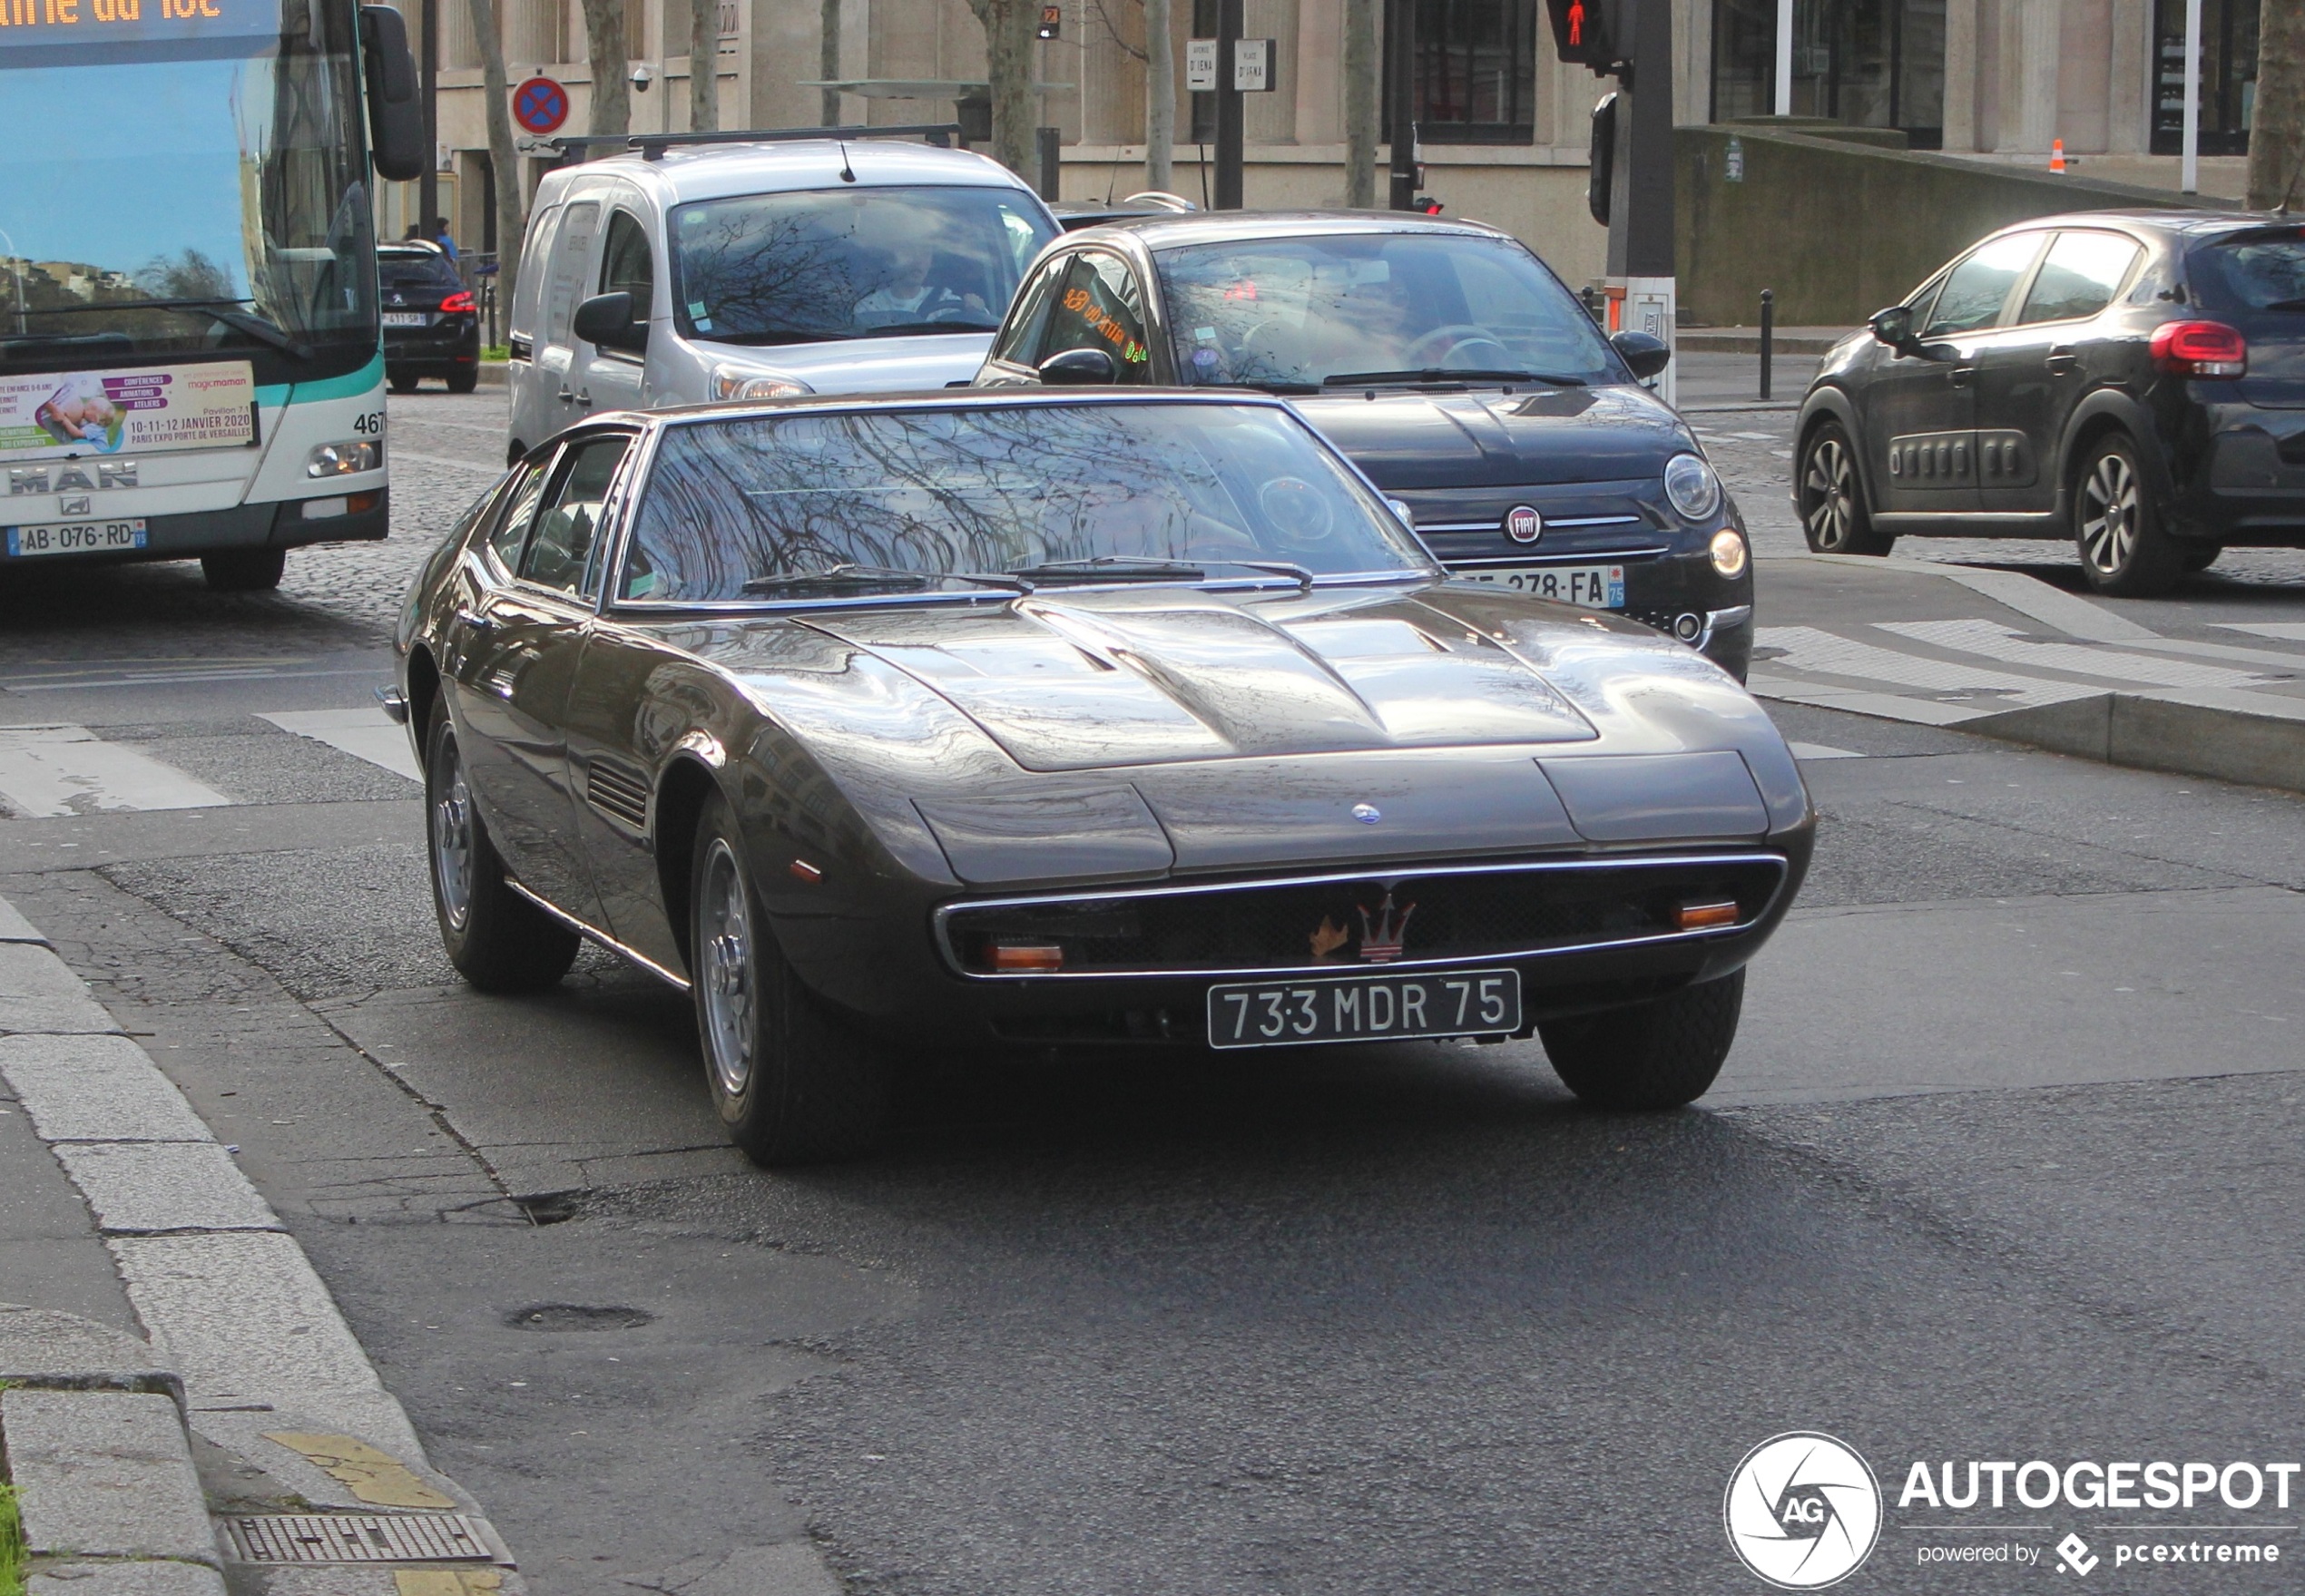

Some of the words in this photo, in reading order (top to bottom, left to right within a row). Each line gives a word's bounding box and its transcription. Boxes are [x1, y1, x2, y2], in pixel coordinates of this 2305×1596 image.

[188, 377, 246, 391] magicmaman
[120, 388, 154, 397] ANIMATIONS
[134, 399, 161, 408] ATELIERS
[203, 406, 236, 416] Pavillon
[238, 406, 250, 414] 7.1
[132, 419, 178, 433] 10-11-12
[181, 416, 221, 429] JANVIER
[224, 414, 250, 426] 2020
[354, 410, 387, 434] 467
[132, 434, 152, 444] PARIS
[154, 432, 172, 443] EXPO
[174, 431, 197, 441] PORTE
[199, 430, 208, 439] DE
[210, 427, 250, 438] VERSAILLES
[10, 462, 138, 494] MAN
[1515, 516, 1535, 534] FIAT
[136, 534, 146, 544] 75
[1610, 587, 1623, 602] 75
[1224, 989, 1317, 1039] 733
[1334, 984, 1427, 1033] MDR
[1446, 979, 1505, 1026] 75
